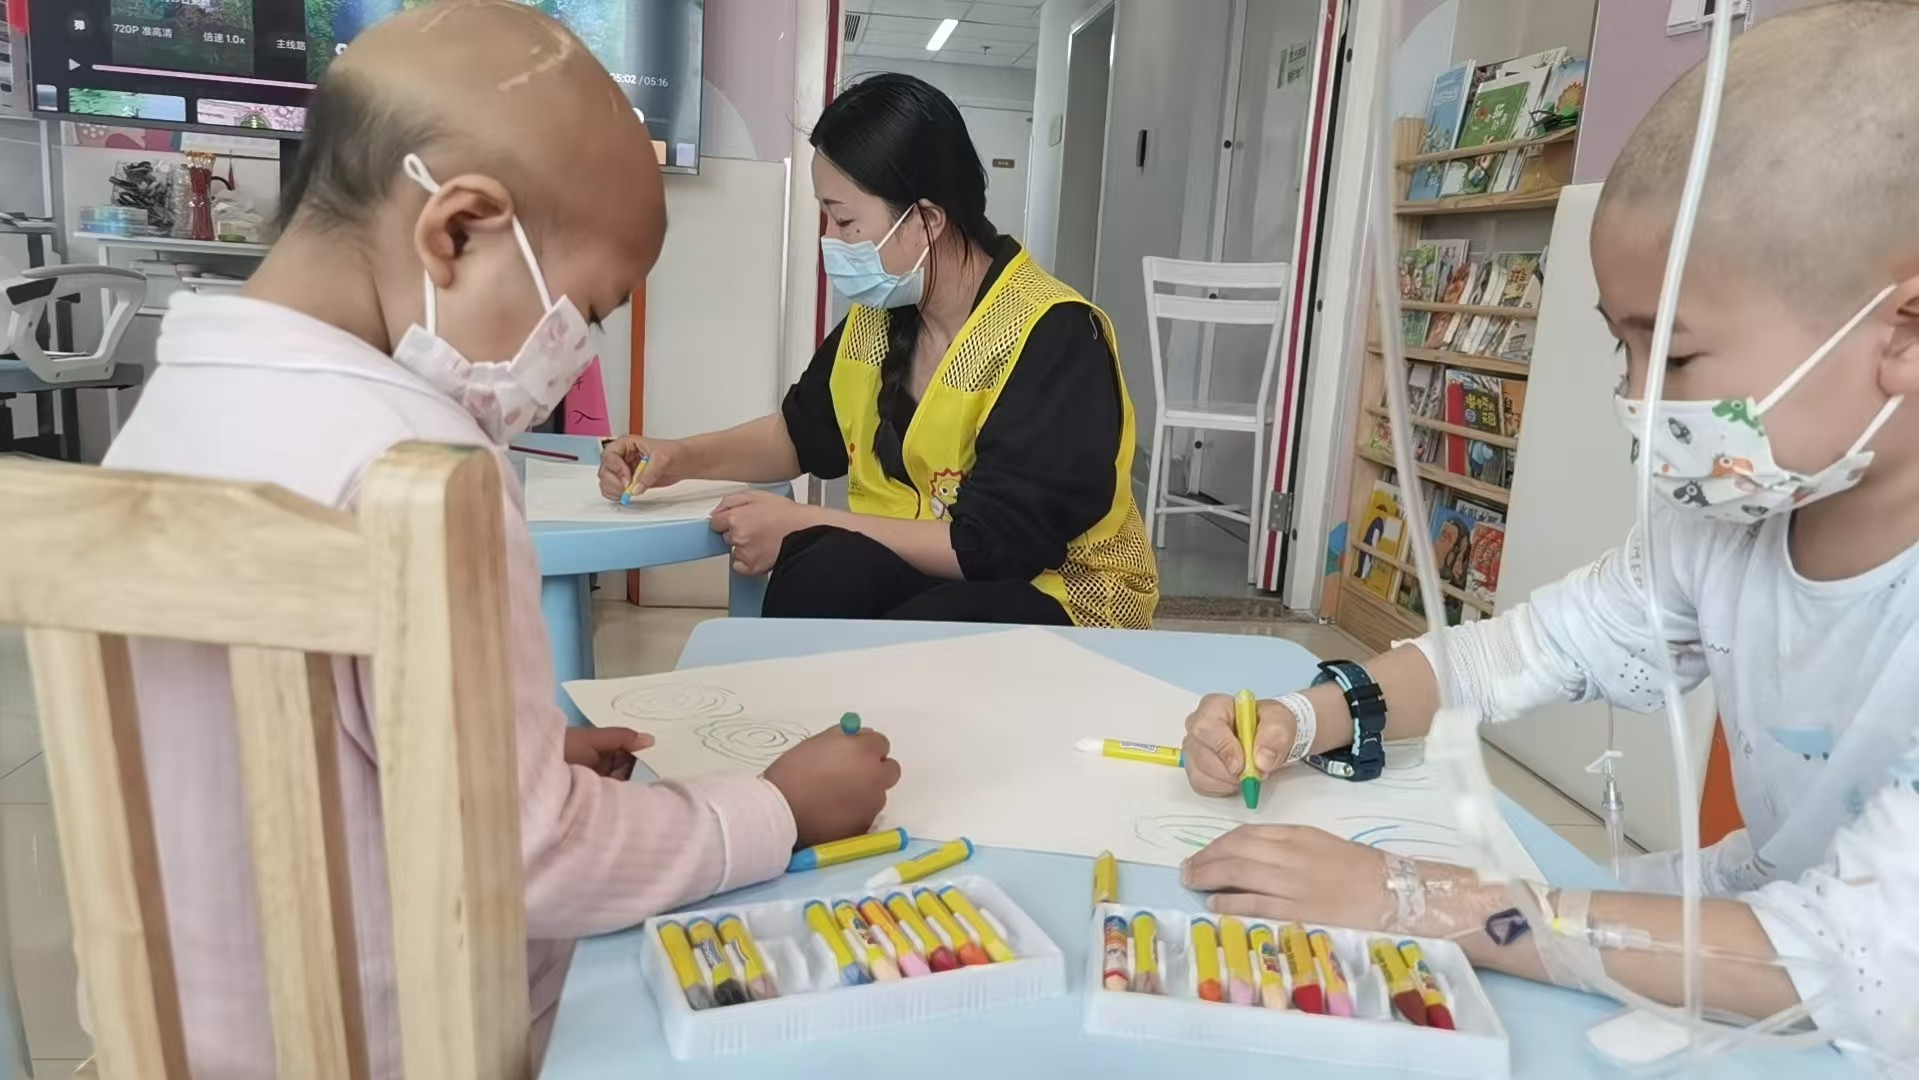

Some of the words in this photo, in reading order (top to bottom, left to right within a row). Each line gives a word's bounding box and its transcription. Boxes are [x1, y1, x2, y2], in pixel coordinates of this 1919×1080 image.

[112, 23, 140, 34] 720P
[141, 26, 173, 38] 准高清
[203, 32, 224, 43] 倍速
[225, 34, 246, 45] 1.0x
[276, 39, 306, 51] 主线路
